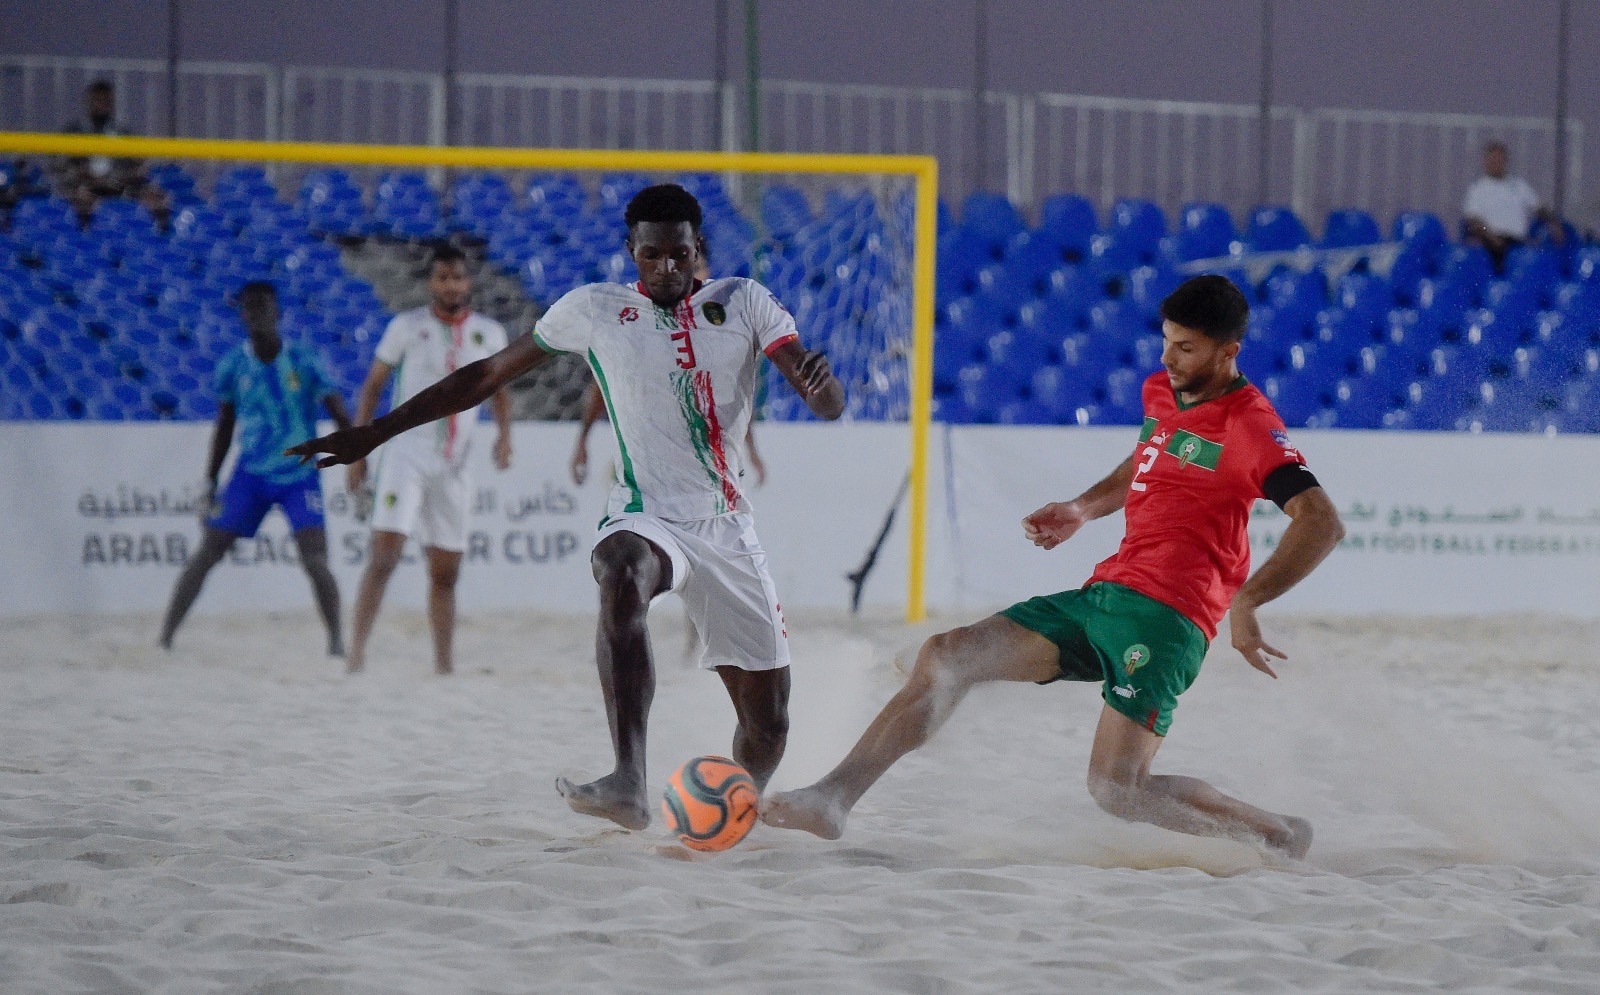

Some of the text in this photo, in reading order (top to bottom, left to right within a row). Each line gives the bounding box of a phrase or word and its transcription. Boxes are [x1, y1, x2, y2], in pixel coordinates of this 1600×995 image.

[671, 331, 697, 370] 3
[1131, 446, 1159, 491] 2
[79, 485, 208, 523] شاطئية
[82, 532, 189, 566] ARAB
[224, 533, 299, 566] EAC
[503, 531, 577, 566] CUP
[1370, 531, 1486, 555] FOOTBALL
